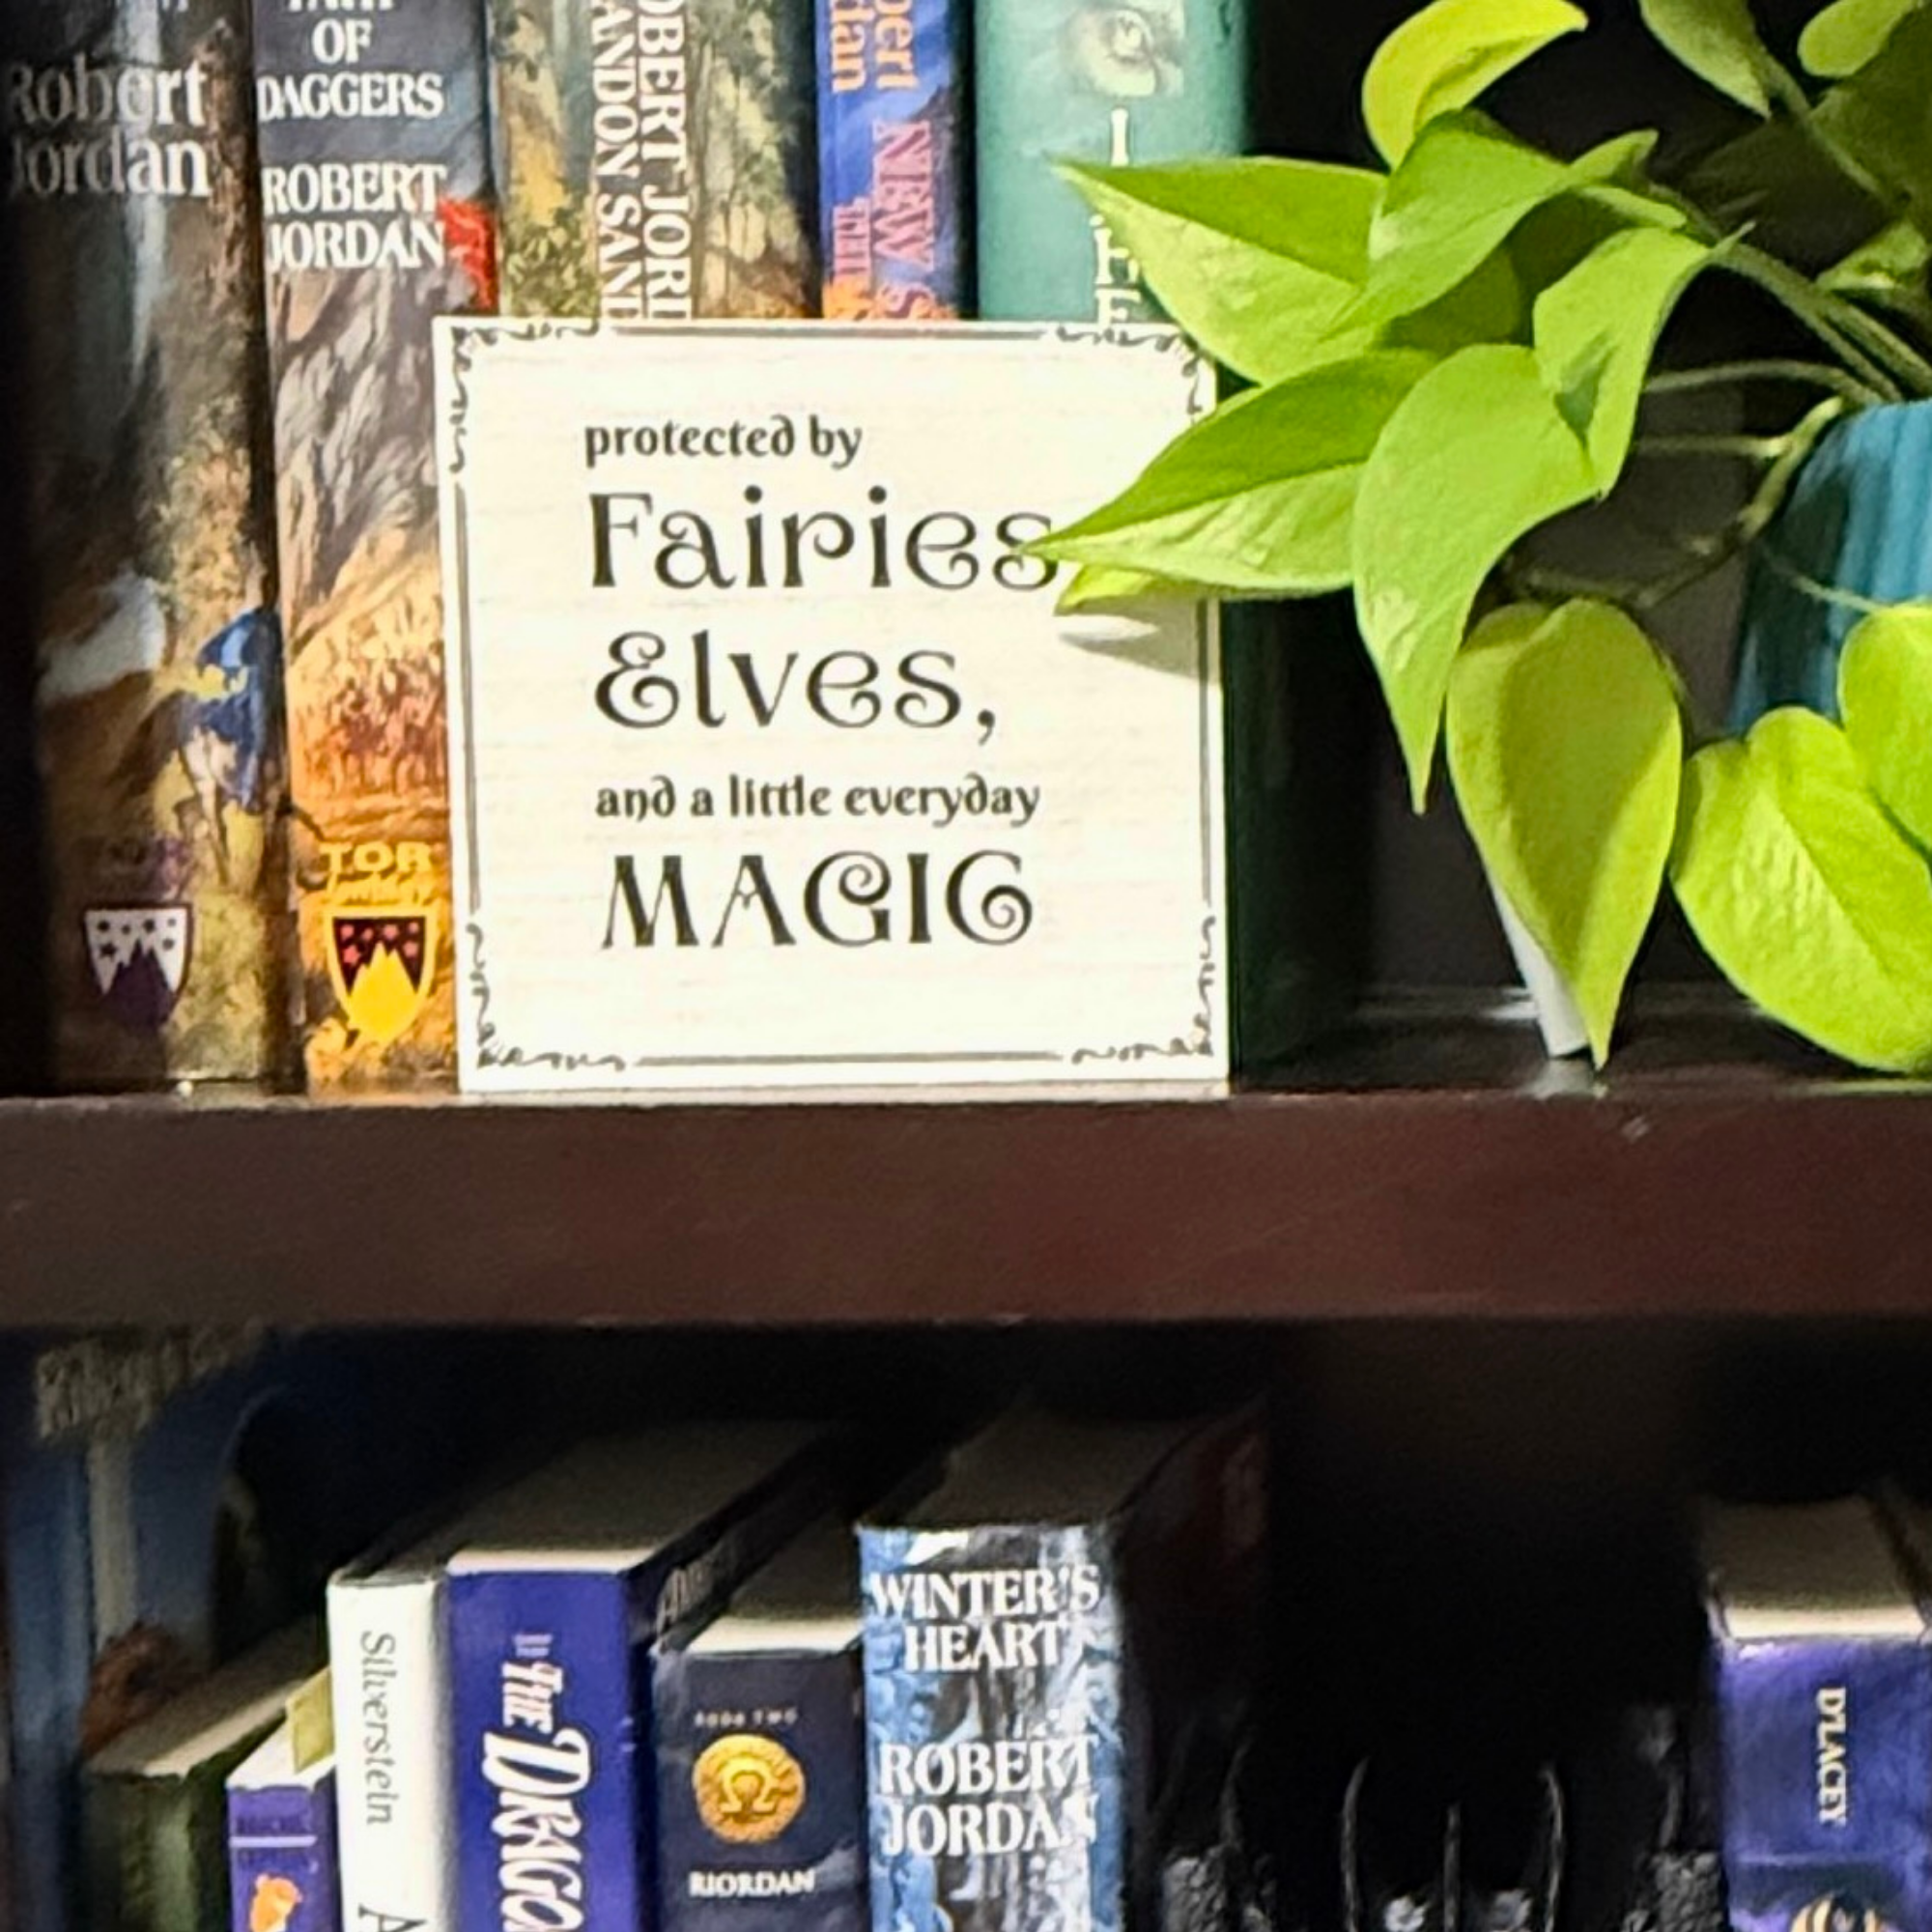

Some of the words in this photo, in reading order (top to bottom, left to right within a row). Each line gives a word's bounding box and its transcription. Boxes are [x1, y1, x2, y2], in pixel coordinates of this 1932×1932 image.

[311, 17, 373, 65] OF
[9, 51, 207, 128] Robert
[257, 72, 444, 120] DAGGERS
[10, 125, 212, 197] Jordan
[261, 162, 447, 214] ROBERT
[872, 120, 934, 271] NEW
[266, 219, 445, 269] JORDAN
[583, 413, 795, 469] protected
[809, 414, 863, 470] by
[588, 484, 1059, 591] Fairies
[594, 629, 996, 746] Elves,
[595, 774, 676, 822] and
[690, 786, 715, 817] a
[728, 773, 831, 818] little
[843, 772, 1040, 828] everyday
[319, 840, 433, 872] TOR
[601, 849, 1033, 949] MAGIC
[870, 1563, 1100, 1621] WINTER'S
[903, 1619, 1067, 1672] HEART
[501, 1660, 564, 1734] THE
[360, 1630, 399, 1826] Silverstein
[880, 1735, 1095, 1797] ROBERT
[881, 1796, 1098, 1858] JORDAN
[689, 1867, 817, 1897] RIORDAN
